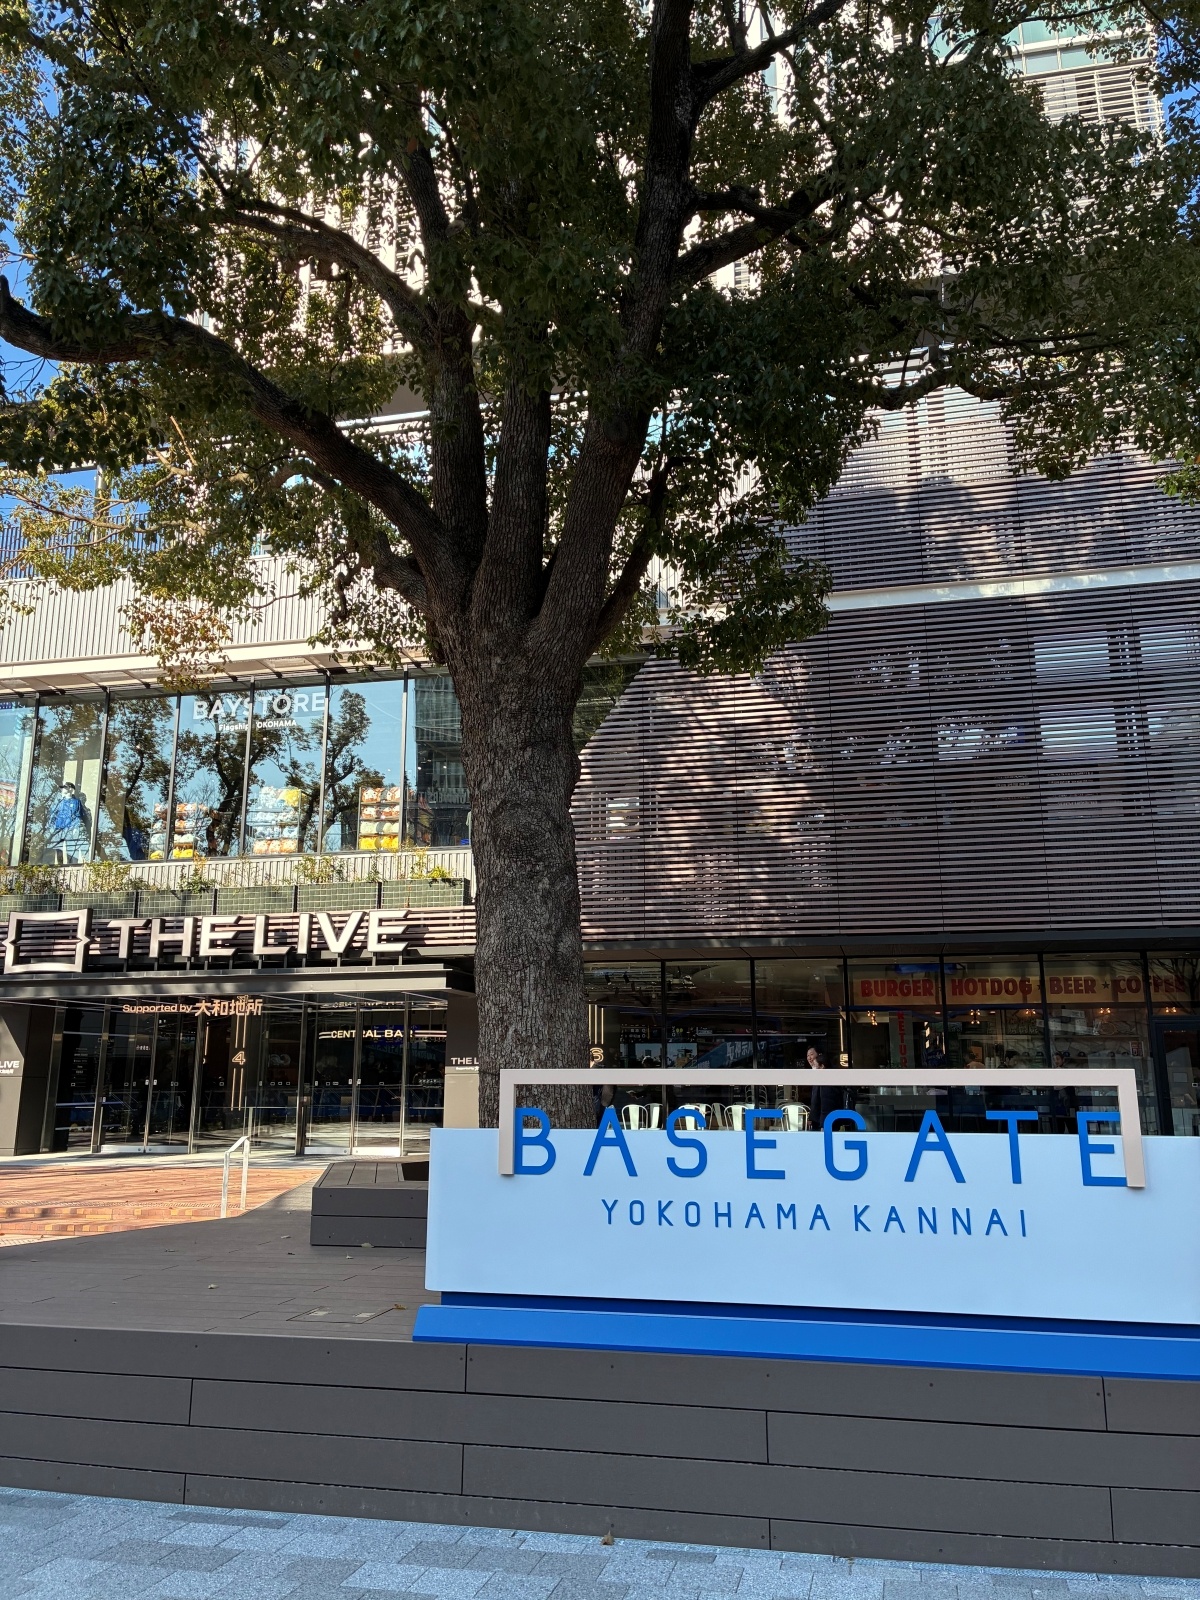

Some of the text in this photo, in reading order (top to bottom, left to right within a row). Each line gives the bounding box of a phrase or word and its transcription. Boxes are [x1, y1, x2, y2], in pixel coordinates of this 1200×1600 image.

[193, 692, 325, 719] BAYSTORE
[256, 720, 297, 729] OKOHAMA
[107, 910, 410, 958] THE LIVE
[861, 979, 934, 997] BURGER
[951, 978, 1032, 996] HOTDOG
[1050, 976, 1096, 994] BEER
[122, 998, 263, 1016] Supported by 大和地所
[232, 1051, 246, 1065] 4
[514, 1107, 1127, 1187] BASEGATE
[601, 1198, 1027, 1237] YOKOHAMA KANNAI
